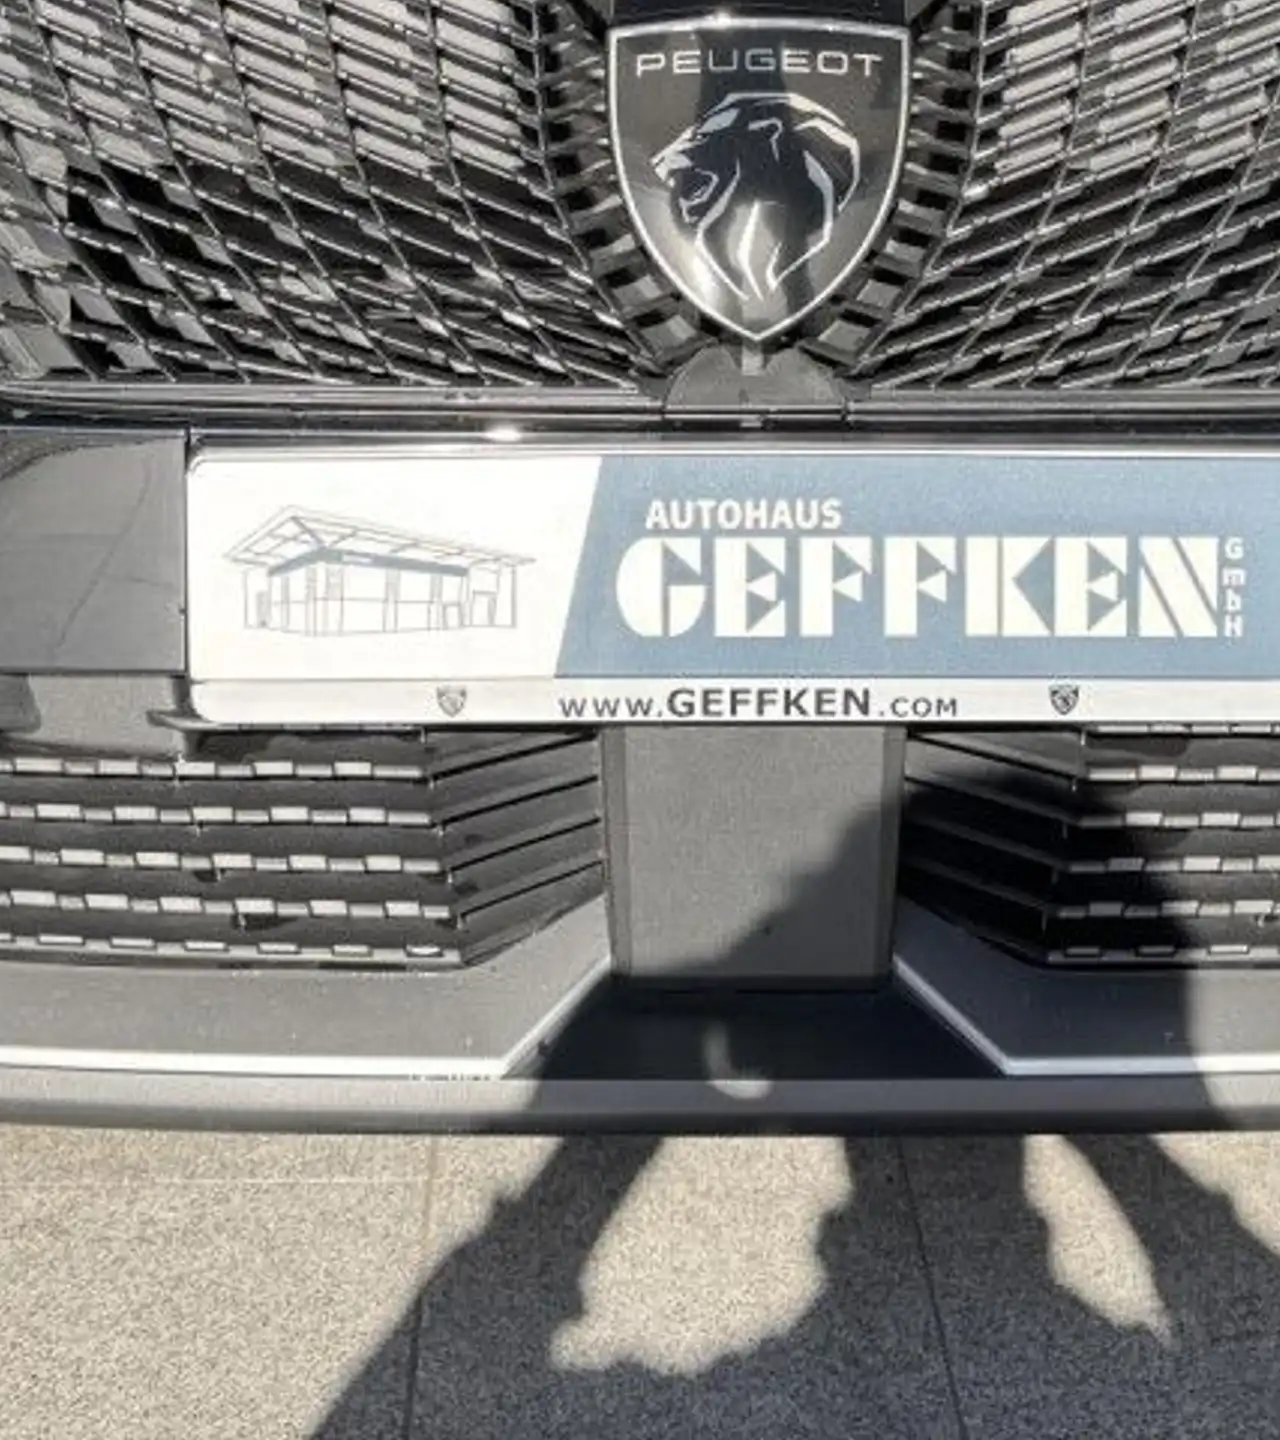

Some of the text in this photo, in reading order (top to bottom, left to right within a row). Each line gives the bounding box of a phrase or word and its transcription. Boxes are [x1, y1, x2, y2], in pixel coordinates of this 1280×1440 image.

[635, 48, 883, 78] PEUGEOT
[645, 498, 842, 531] AUTOHAUS
[615, 536, 1219, 638] GEFFKEN
[1222, 537, 1246, 638] GmbH
